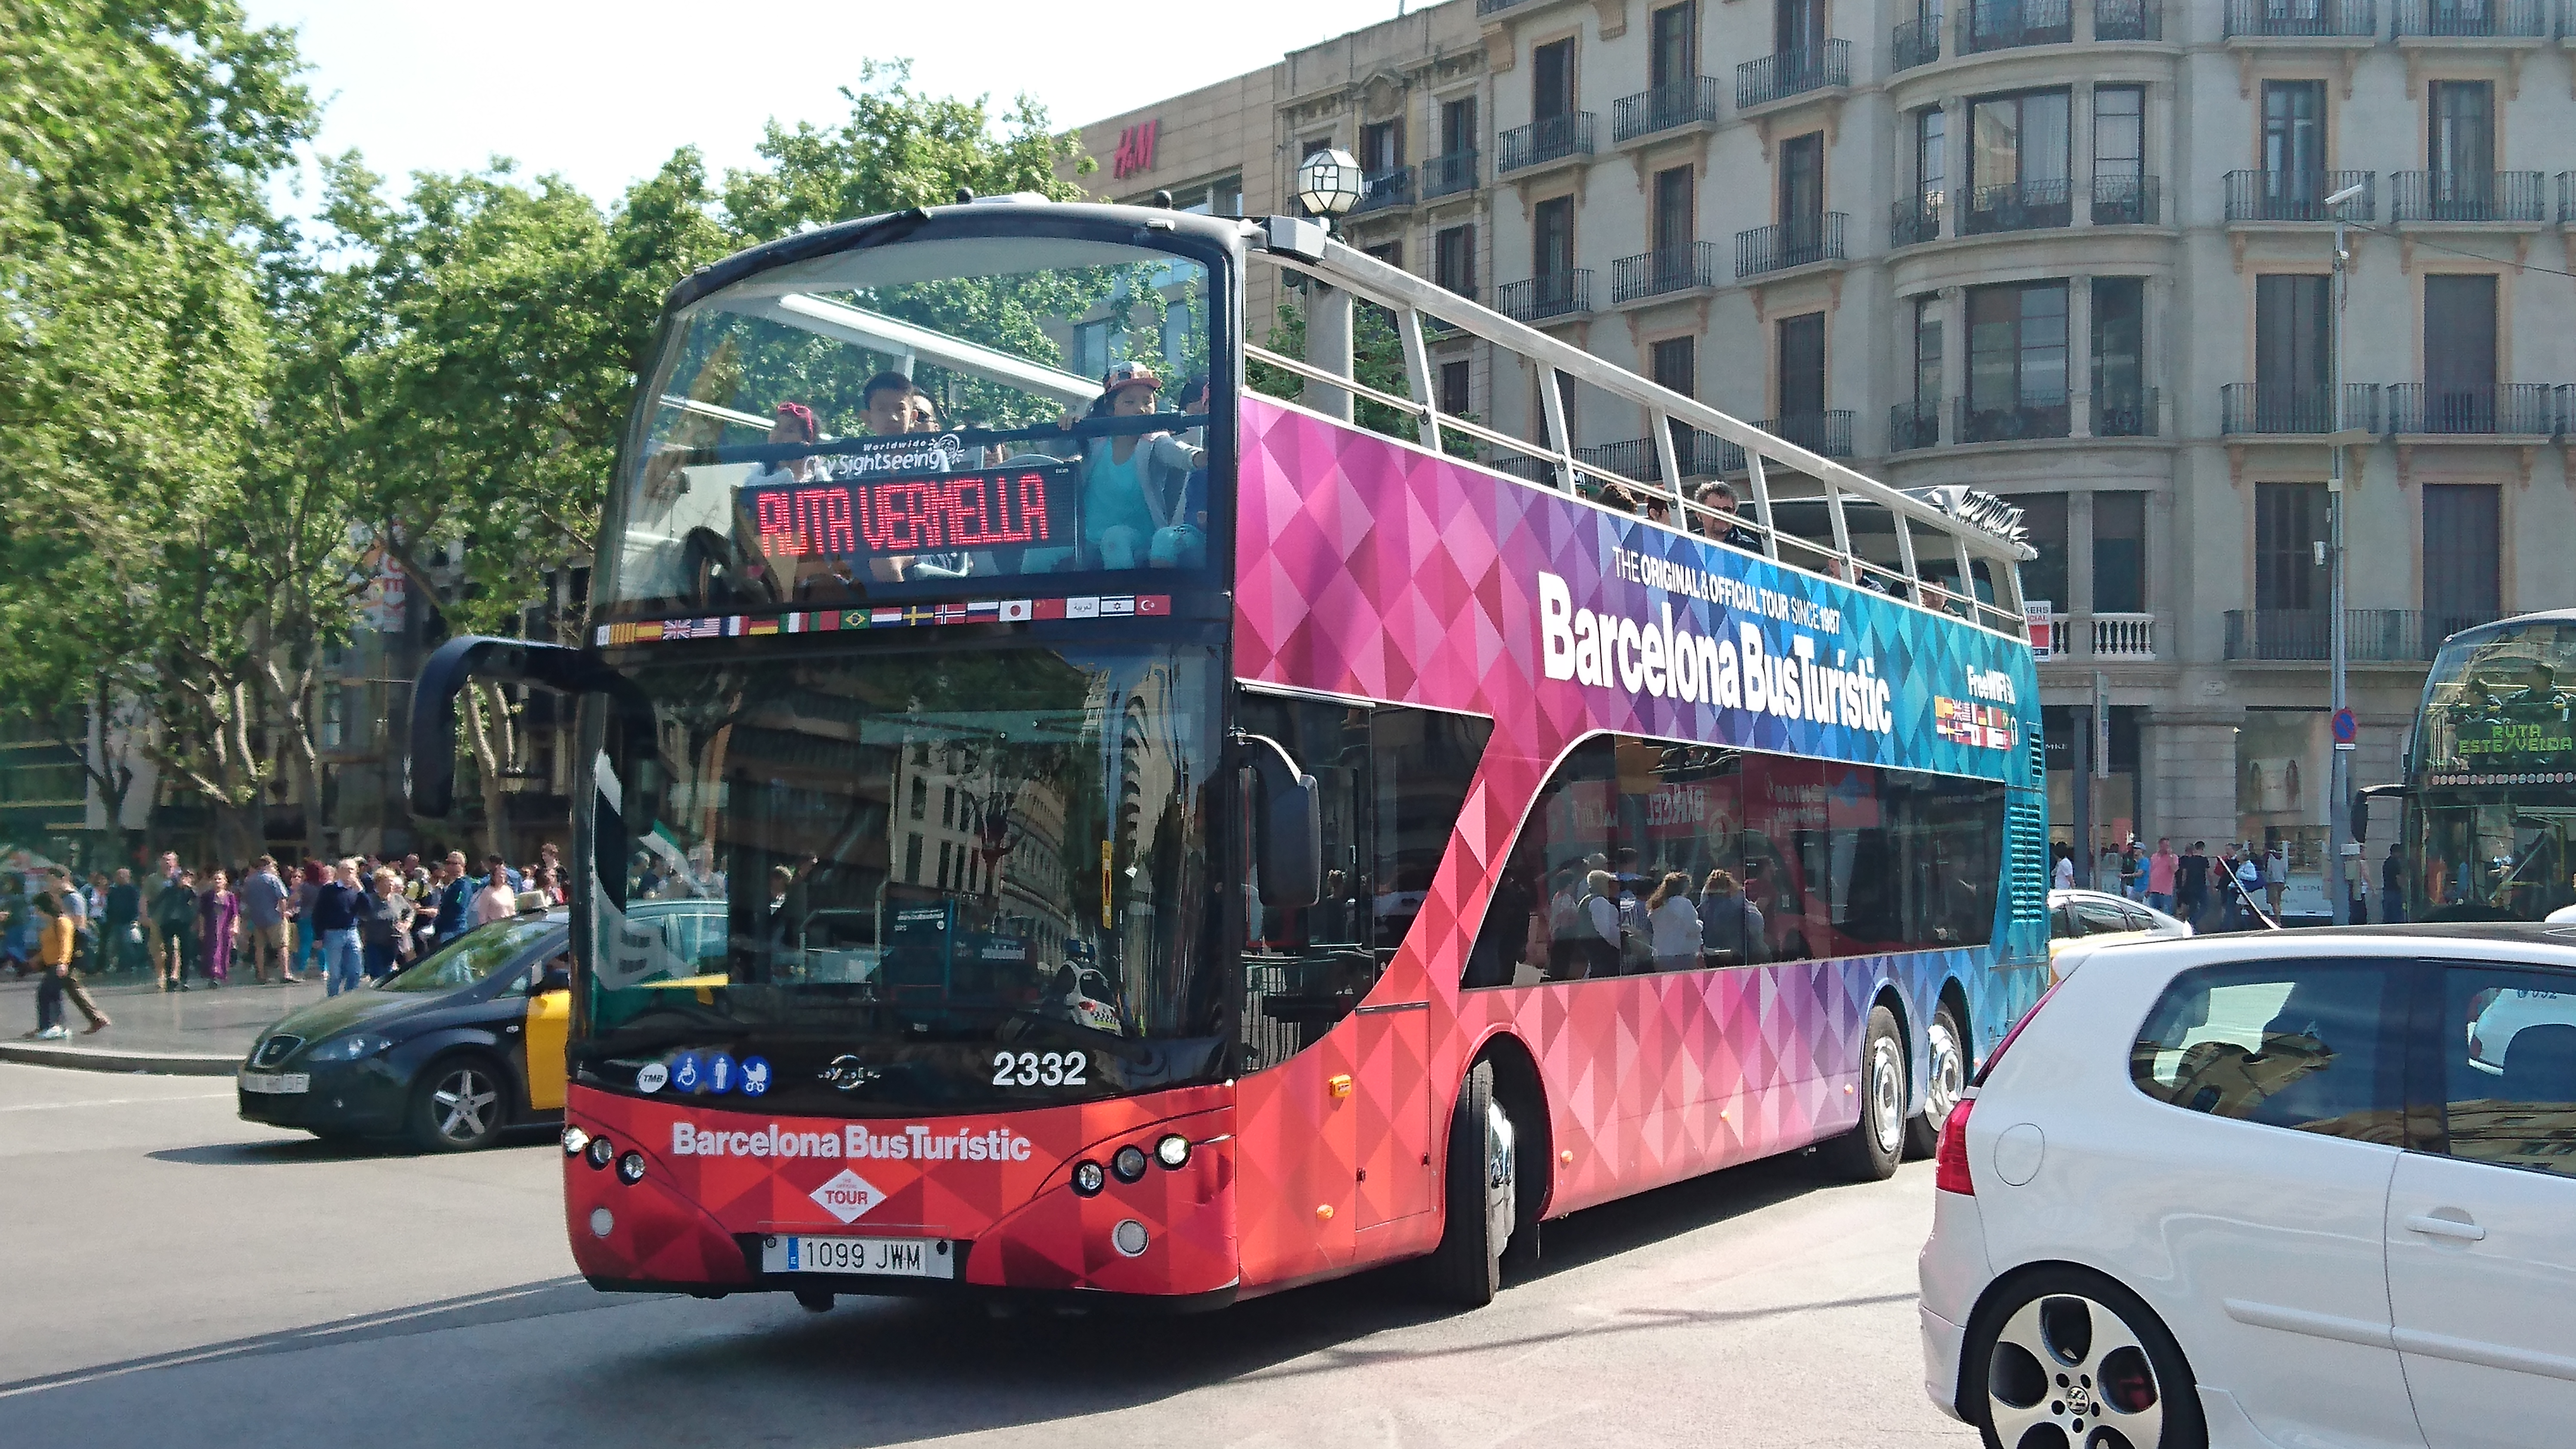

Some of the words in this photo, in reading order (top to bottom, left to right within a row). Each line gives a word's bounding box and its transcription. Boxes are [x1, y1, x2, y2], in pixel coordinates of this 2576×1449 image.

[1113, 118, 1157, 179] H&M
[863, 440, 926, 452] Worldwide
[838, 450, 939, 476] Sightseeing
[758, 486, 855, 558] RUTA
[860, 474, 1050, 552] VERMELLA
[1612, 546, 1641, 583] THE
[1641, 554, 1701, 598] ORIGINAL
[1700, 570, 1710, 601] &
[1709, 574, 1761, 614] OFFICIAL
[1759, 588, 1790, 622] TOUR
[1790, 596, 1821, 630] SINCE
[1820, 607, 1841, 635] 1987
[1538, 571, 1742, 709] Barcelona
[2491, 724, 2541, 739] RUTA
[644, 1074, 664, 1083] TMB
[992, 1051, 1086, 1086] 2332
[672, 1122, 840, 1158] Barcelona
[844, 1124, 1032, 1161] BusTurístic
[825, 1190, 868, 1205] TOUR
[790, 1257, 797, 1265] E
[807, 1242, 864, 1268] 1099
[875, 1243, 920, 1270] JWM
